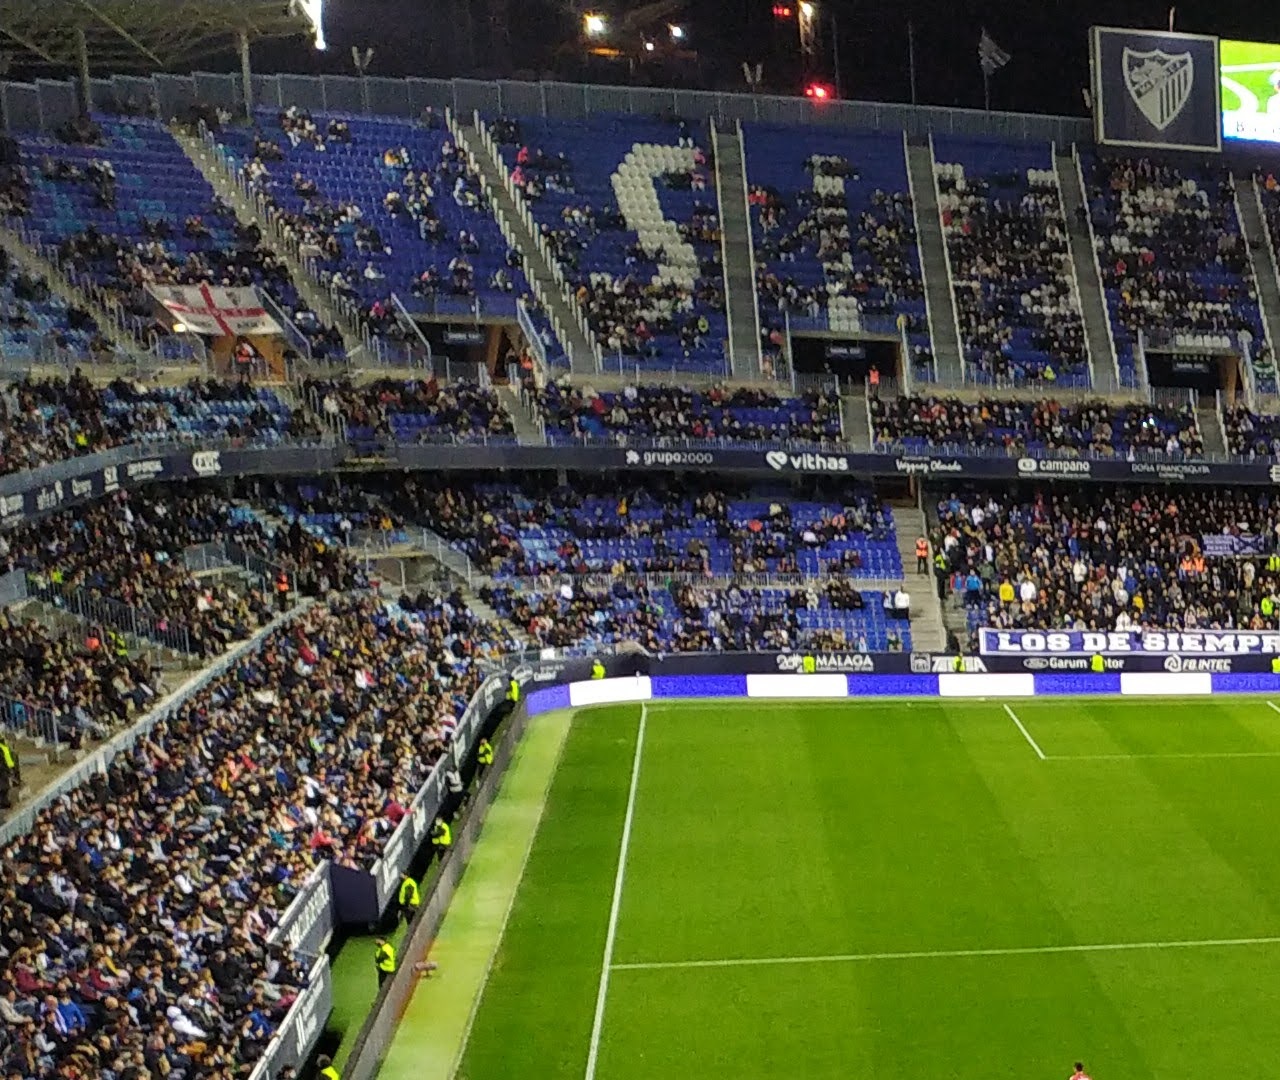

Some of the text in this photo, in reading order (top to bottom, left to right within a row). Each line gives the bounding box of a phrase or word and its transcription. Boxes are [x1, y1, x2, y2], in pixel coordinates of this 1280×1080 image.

[790, 453, 848, 471] vithas
[1039, 459, 1091, 473] campano
[998, 632, 1070, 651] LOS
[1083, 633, 1132, 651] DE
[1050, 658, 1087, 669] Garum
[1090, 658, 1124, 669] otor
